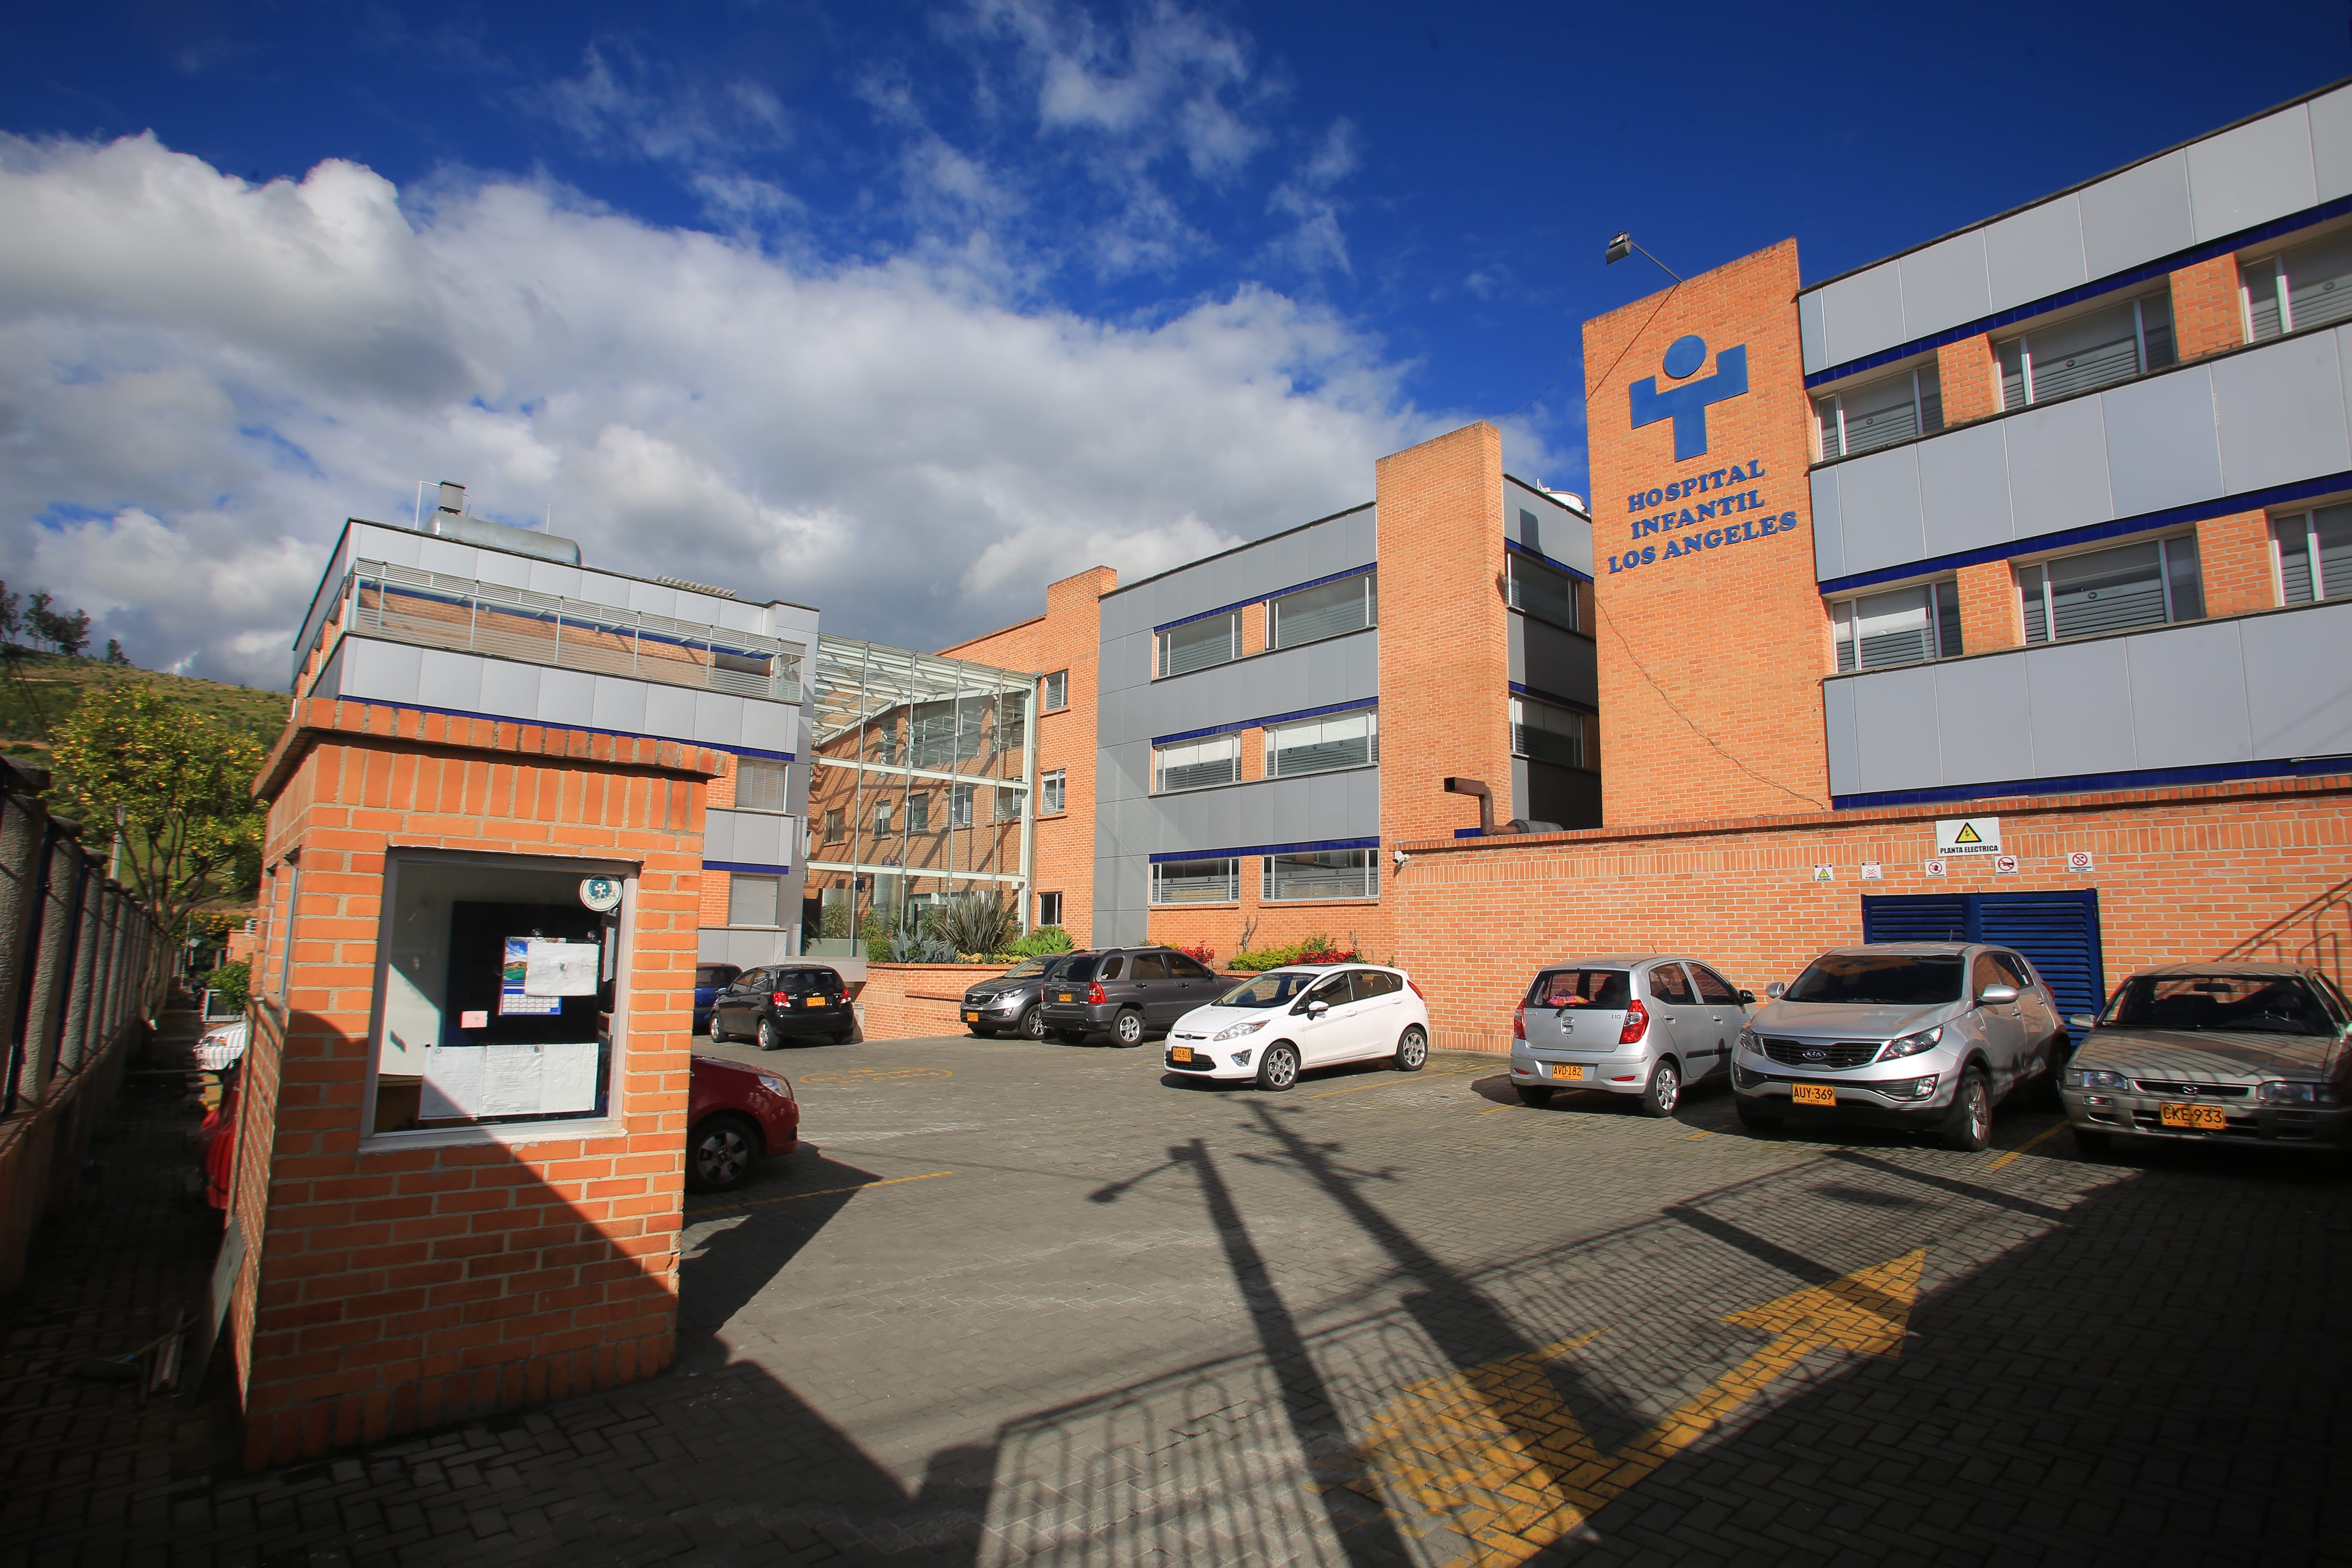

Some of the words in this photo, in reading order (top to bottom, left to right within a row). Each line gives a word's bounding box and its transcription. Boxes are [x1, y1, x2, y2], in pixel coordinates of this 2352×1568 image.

[1627, 459, 1765, 512] HOSPITAL
[1631, 490, 1764, 539] INFANTIL
[1608, 550, 1656, 574] LOS
[1662, 511, 1797, 560] ANGELES
